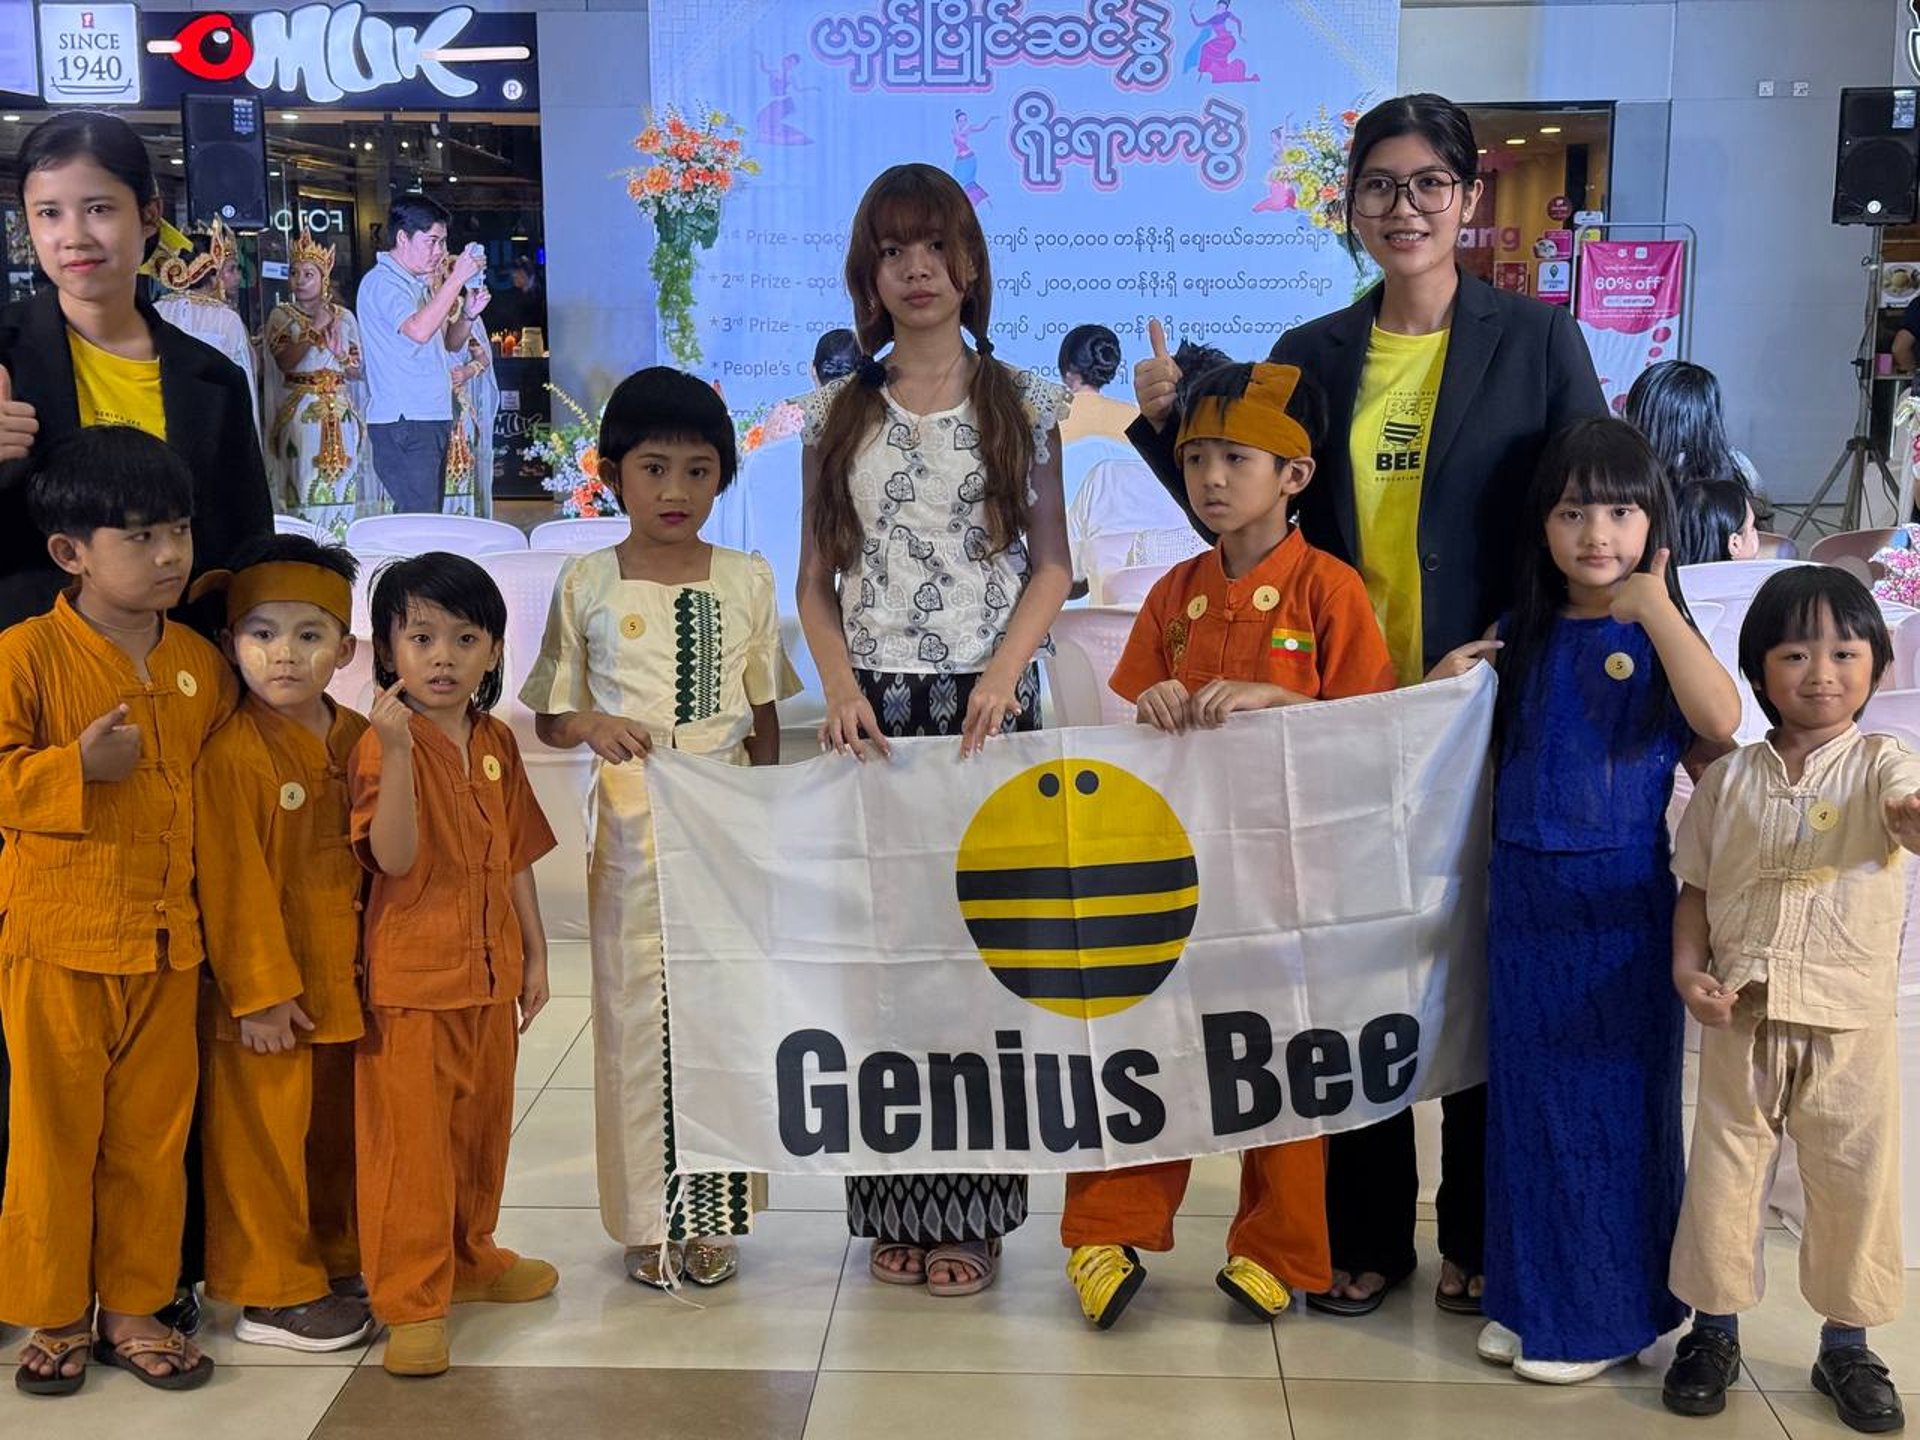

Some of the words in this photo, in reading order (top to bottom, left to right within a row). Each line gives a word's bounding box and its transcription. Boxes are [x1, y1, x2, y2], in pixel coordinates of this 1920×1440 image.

[59, 33, 121, 50] SINCE
[58, 55, 122, 82] 1940
[746, 229, 788, 245] Prize
[1456, 226, 1521, 251] ang
[721, 273, 745, 289] 2nd
[750, 274, 791, 289] Prize
[1595, 276, 1632, 291] 60%
[721, 316, 744, 333] 3rd
[749, 317, 790, 332] Prize
[723, 360, 791, 378] People's
[1375, 451, 1421, 471] BEE
[1616, 661, 1624, 670] 5
[775, 1028, 1166, 1157] Genius
[1201, 1010, 1420, 1136] Bee
